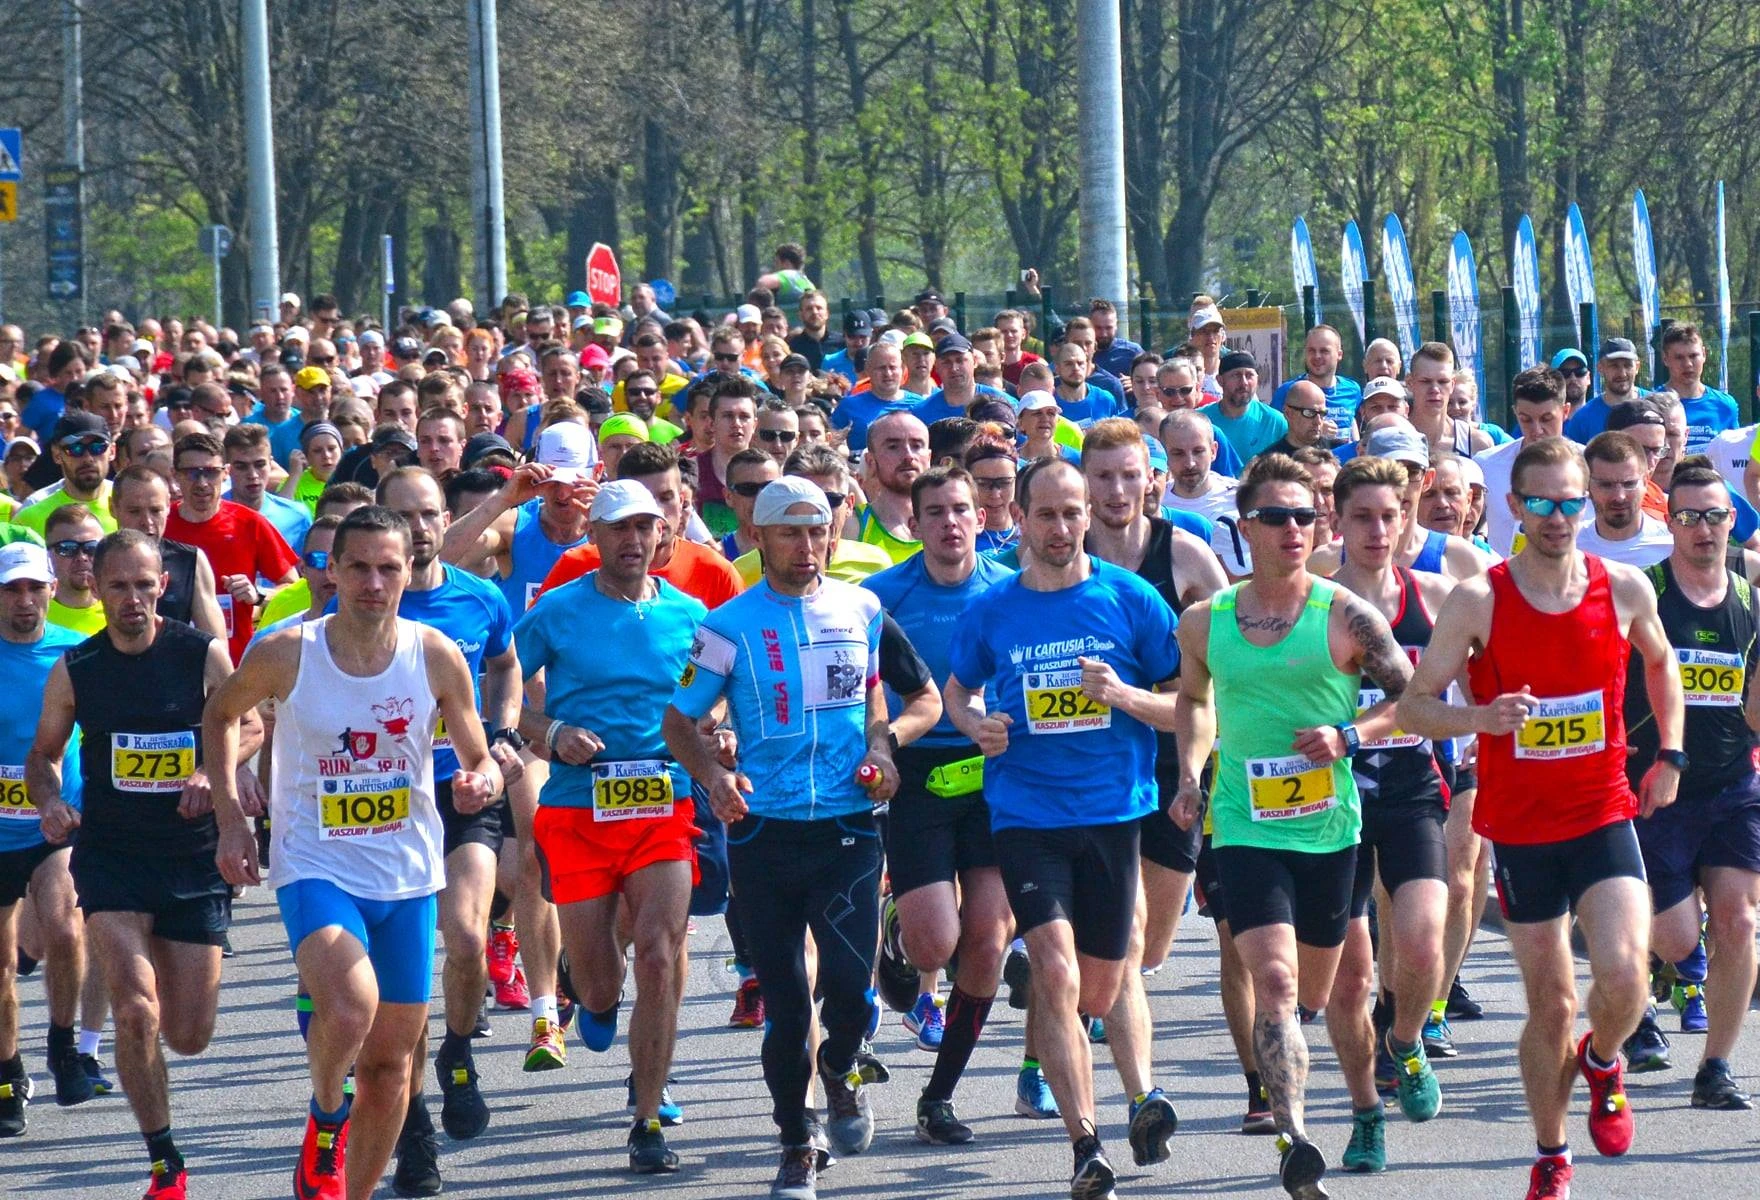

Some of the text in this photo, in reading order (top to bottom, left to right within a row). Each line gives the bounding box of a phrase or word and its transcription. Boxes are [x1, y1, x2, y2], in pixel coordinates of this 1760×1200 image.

[591, 268, 617, 295] STOP
[761, 628, 784, 672] BIKE
[1034, 638, 1085, 657] CARTUSIA
[1046, 674, 1082, 688] KARTUS
[1683, 667, 1734, 692] 306
[1039, 690, 1098, 718] 282
[1034, 721, 1070, 730] KASZUBY
[1535, 718, 1586, 746] 215
[1524, 748, 1561, 758] KASZUBY
[126, 752, 181, 778] 273
[318, 758, 350, 776] RUN
[119, 780, 154, 789] KASZUBY
[602, 778, 667, 805] 1983
[1282, 777, 1305, 804] 2
[337, 795, 395, 824] 108
[601, 807, 634, 818] KASZUBY
[1260, 807, 1297, 819] KASZUBY
[328, 826, 369, 837] KASZUBY
